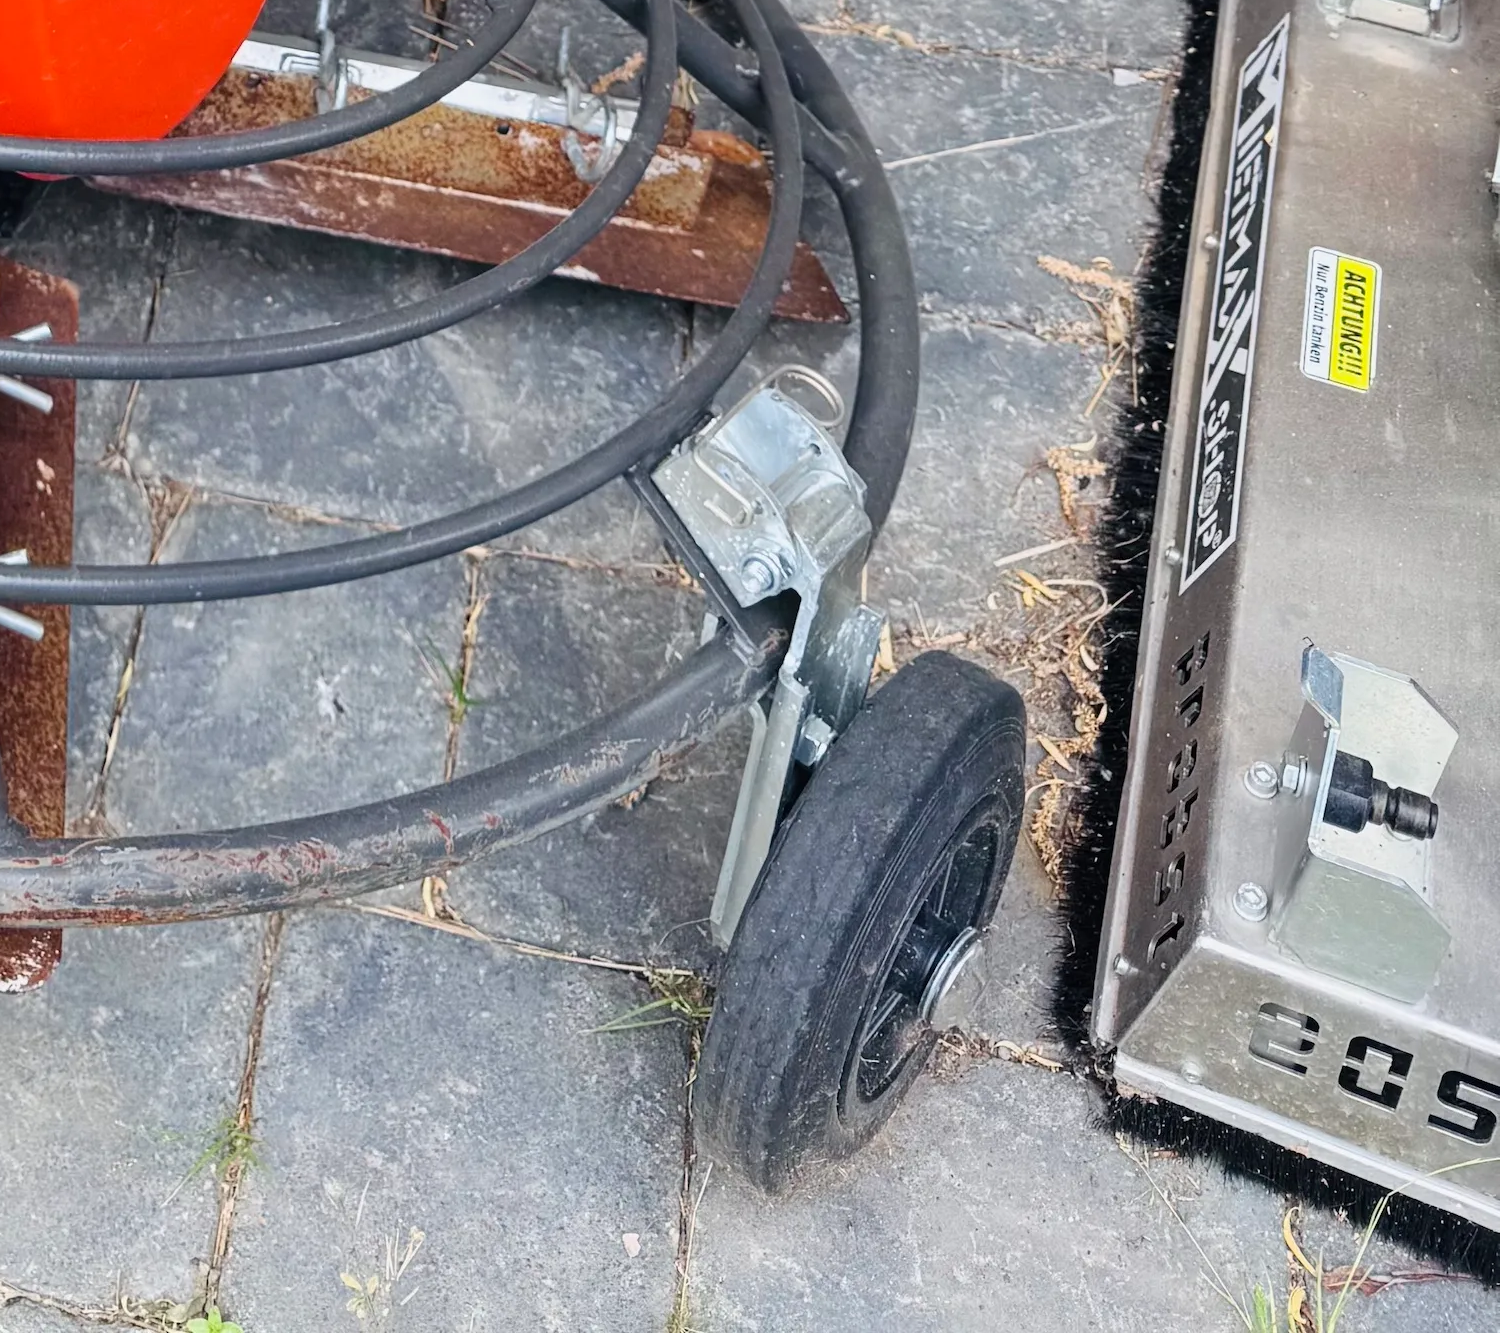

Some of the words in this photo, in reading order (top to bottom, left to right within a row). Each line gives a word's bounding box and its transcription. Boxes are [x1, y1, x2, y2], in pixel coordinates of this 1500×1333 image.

[1316, 262, 1331, 282] Nur
[1312, 284, 1329, 322] Benzin
[1337, 269, 1367, 376] ACHTUNG!!!
[1309, 324, 1325, 364] tanken
